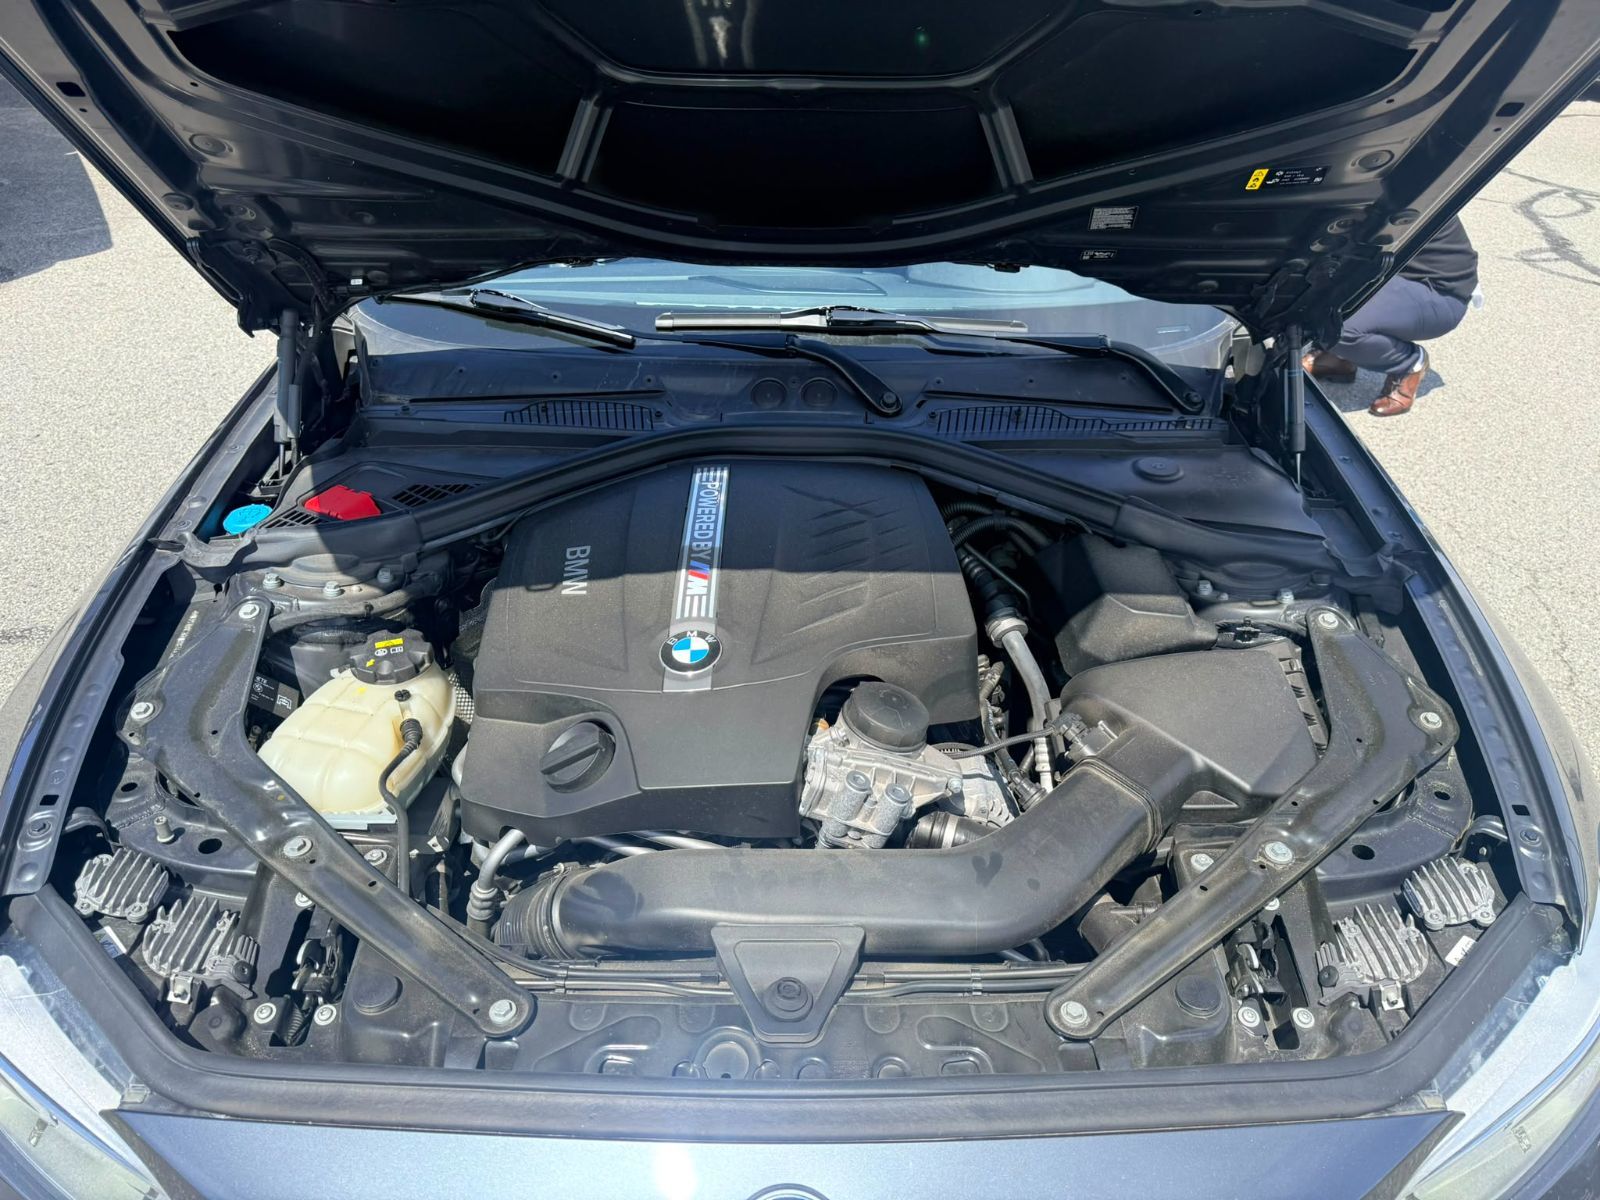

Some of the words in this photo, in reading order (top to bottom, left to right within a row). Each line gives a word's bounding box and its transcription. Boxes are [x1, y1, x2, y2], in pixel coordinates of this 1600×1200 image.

[693, 481, 720, 539] POWERED
[690, 541, 712, 560] BY
[561, 545, 591, 595] BMW
[666, 630, 717, 645] BMW
